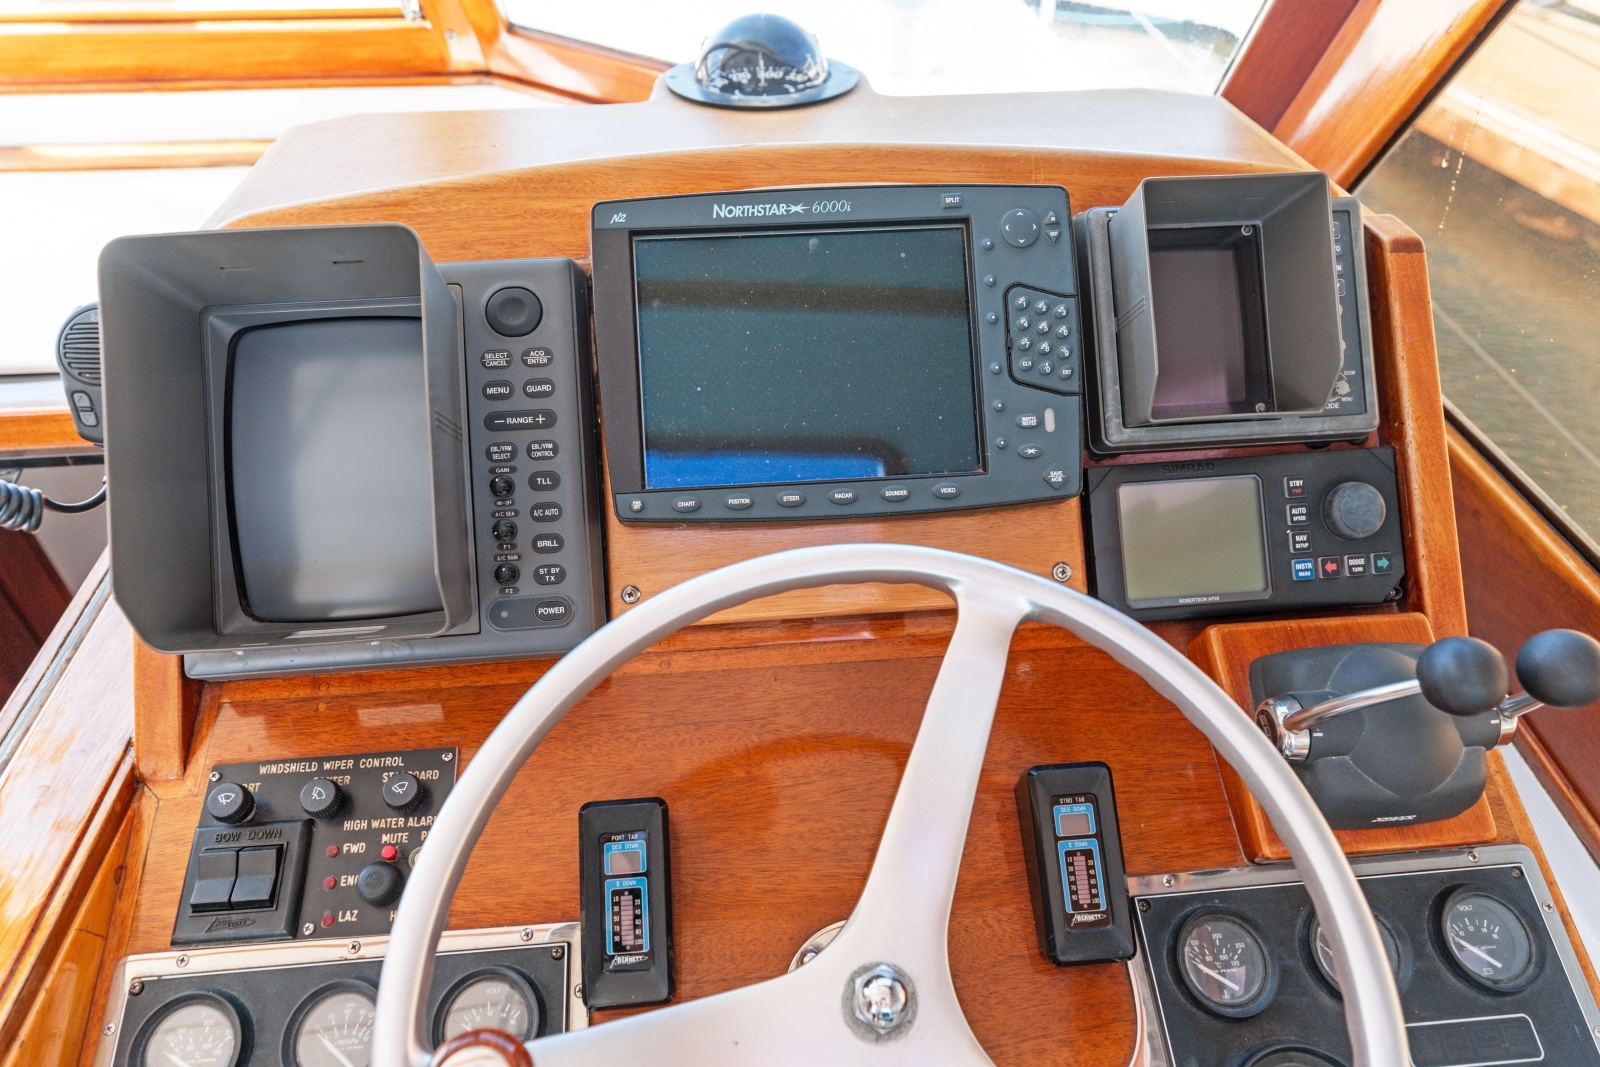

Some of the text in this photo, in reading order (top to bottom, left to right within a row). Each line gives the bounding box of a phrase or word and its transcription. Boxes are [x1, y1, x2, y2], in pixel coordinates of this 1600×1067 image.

[712, 200, 852, 218] NORTHSTAR 6000i
[1162, 462, 1215, 475] SIMRAD
[259, 756, 405, 775] WINDSHIELD WIPER CONTROL
[382, 770, 439, 782] STOARD
[343, 820, 368, 831] HIGH
[371, 818, 404, 829] WATER
[215, 829, 282, 843] BOW DOWN
[382, 832, 409, 844] MUTE
[343, 842, 366, 854] FWD
[338, 910, 358, 922] LAZ
